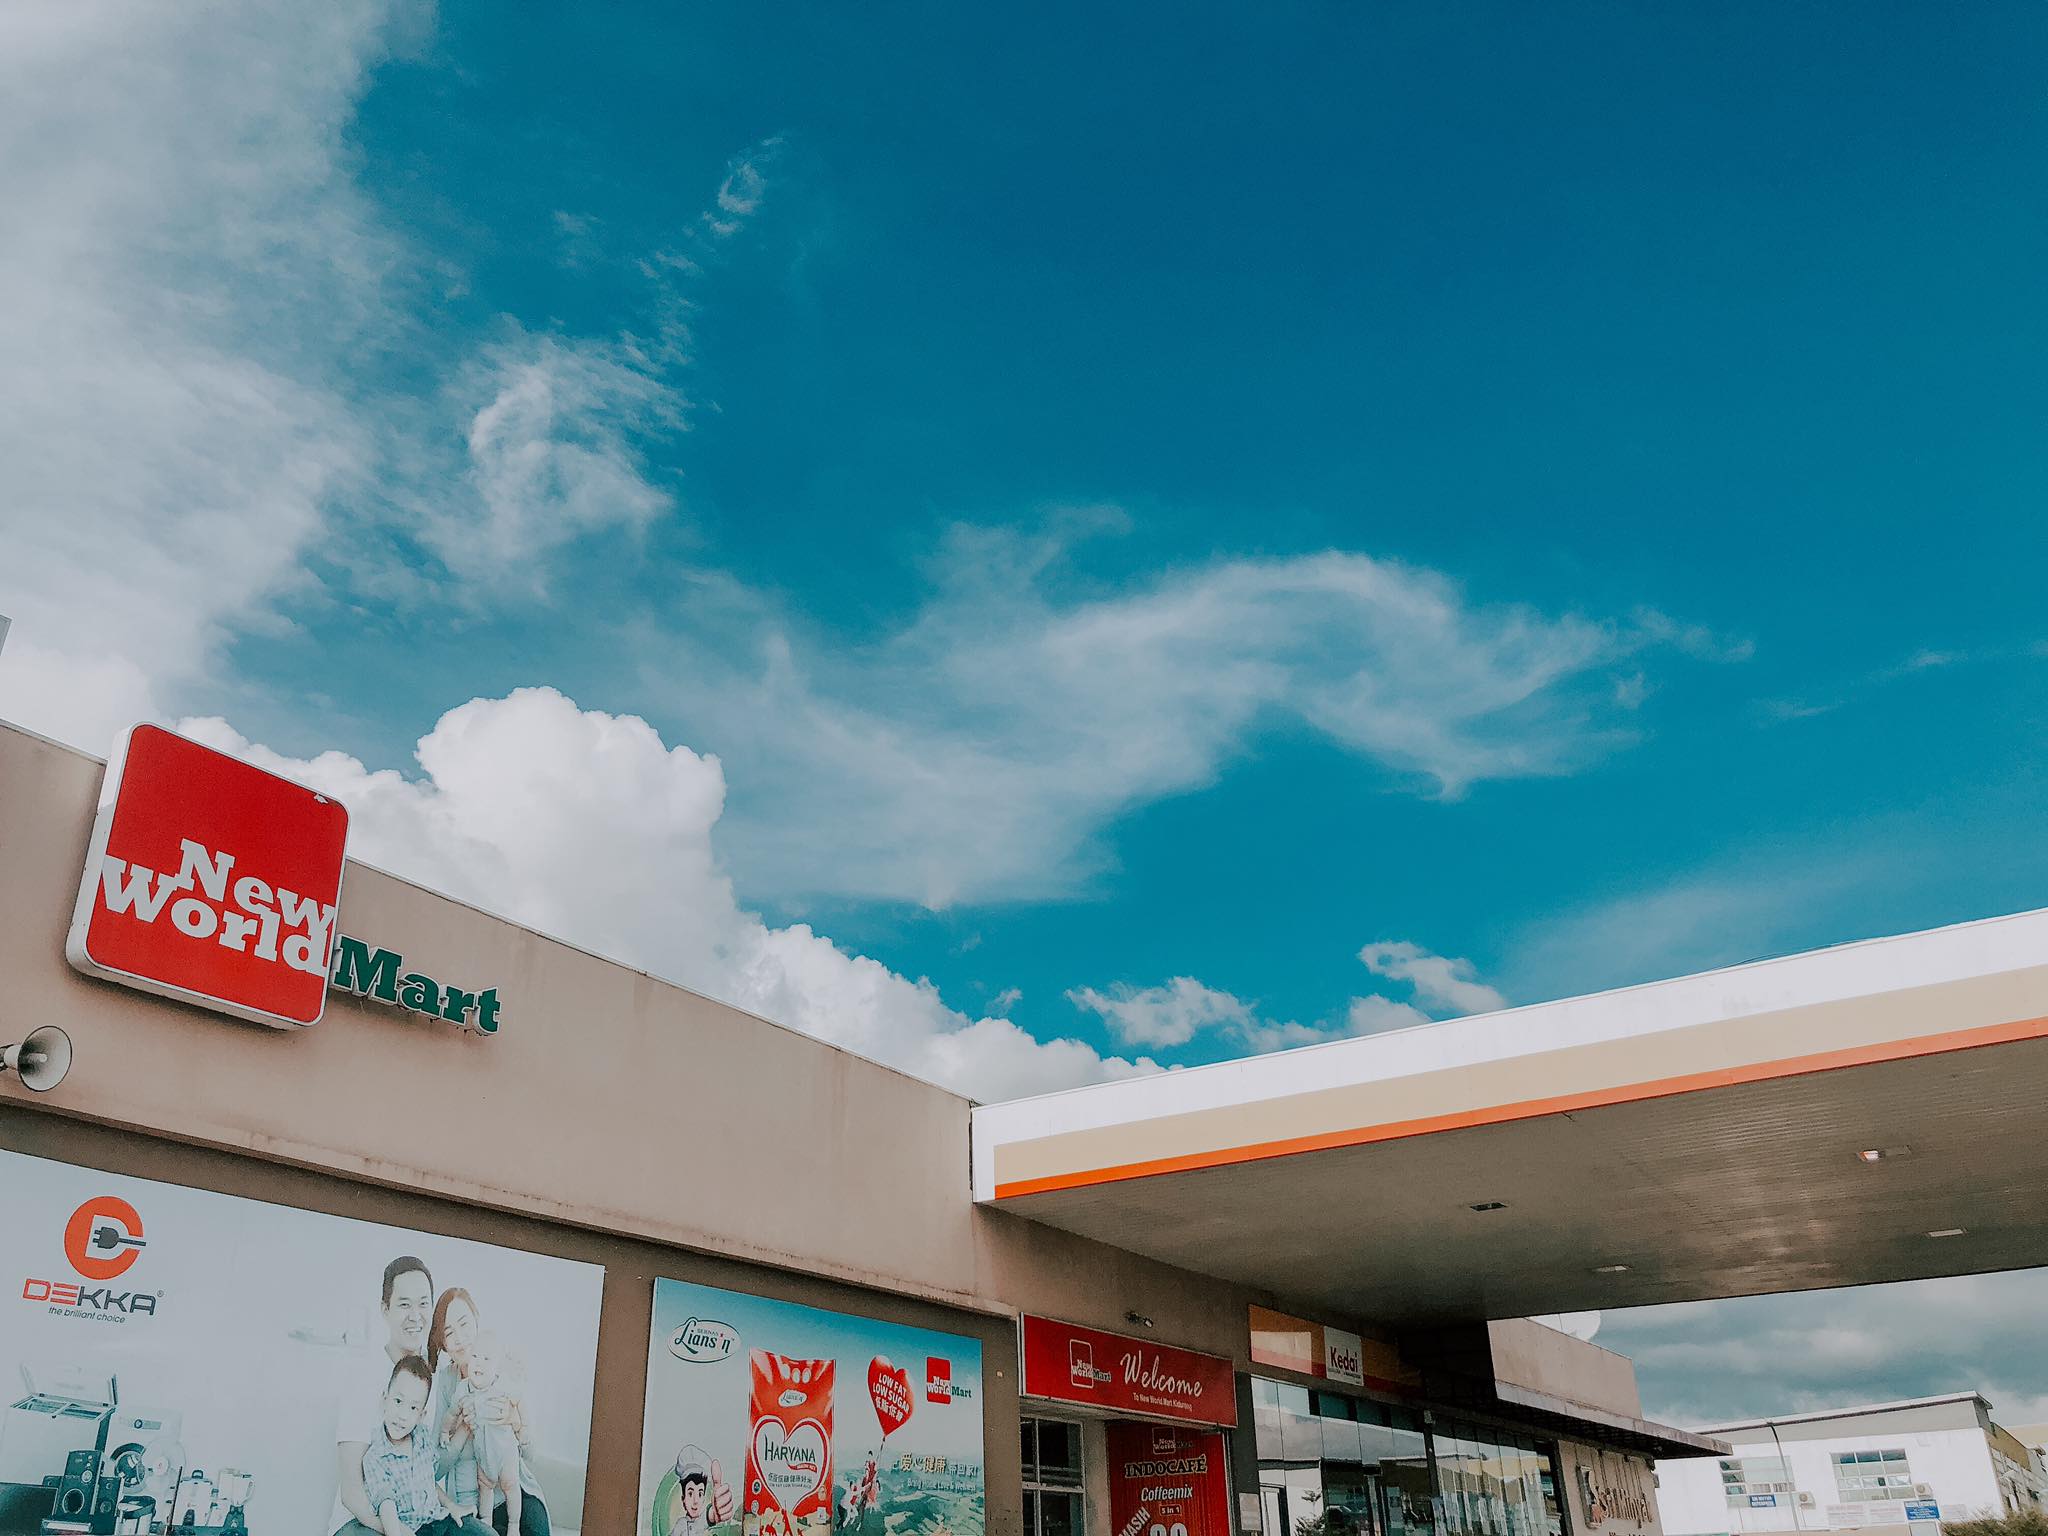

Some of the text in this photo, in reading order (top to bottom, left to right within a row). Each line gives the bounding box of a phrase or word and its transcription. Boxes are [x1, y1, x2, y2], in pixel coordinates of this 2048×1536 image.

[175, 838, 335, 934] New
[101, 854, 501, 1035] World Mart
[23, 1278, 157, 1316] DEKKA
[48, 1306, 126, 1324] the brilliant choice
[1330, 1346, 1358, 1373] Kedai
[933, 1376, 951, 1387] New
[1071, 1364, 1094, 1378] World
[1120, 1349, 1203, 1398] Welcome
[872, 1382, 888, 1398] LOW
[878, 1373, 907, 1398] LOW FAT
[926, 1382, 972, 1398] World Mart
[1132, 1392, 1140, 1402] To
[764, 1434, 816, 1463] HARYANA
[1125, 1453, 1208, 1478] INDOCAFÉ
[1141, 1483, 1193, 1501] Coffeemix
[1166, 1506, 1174, 1514] in
